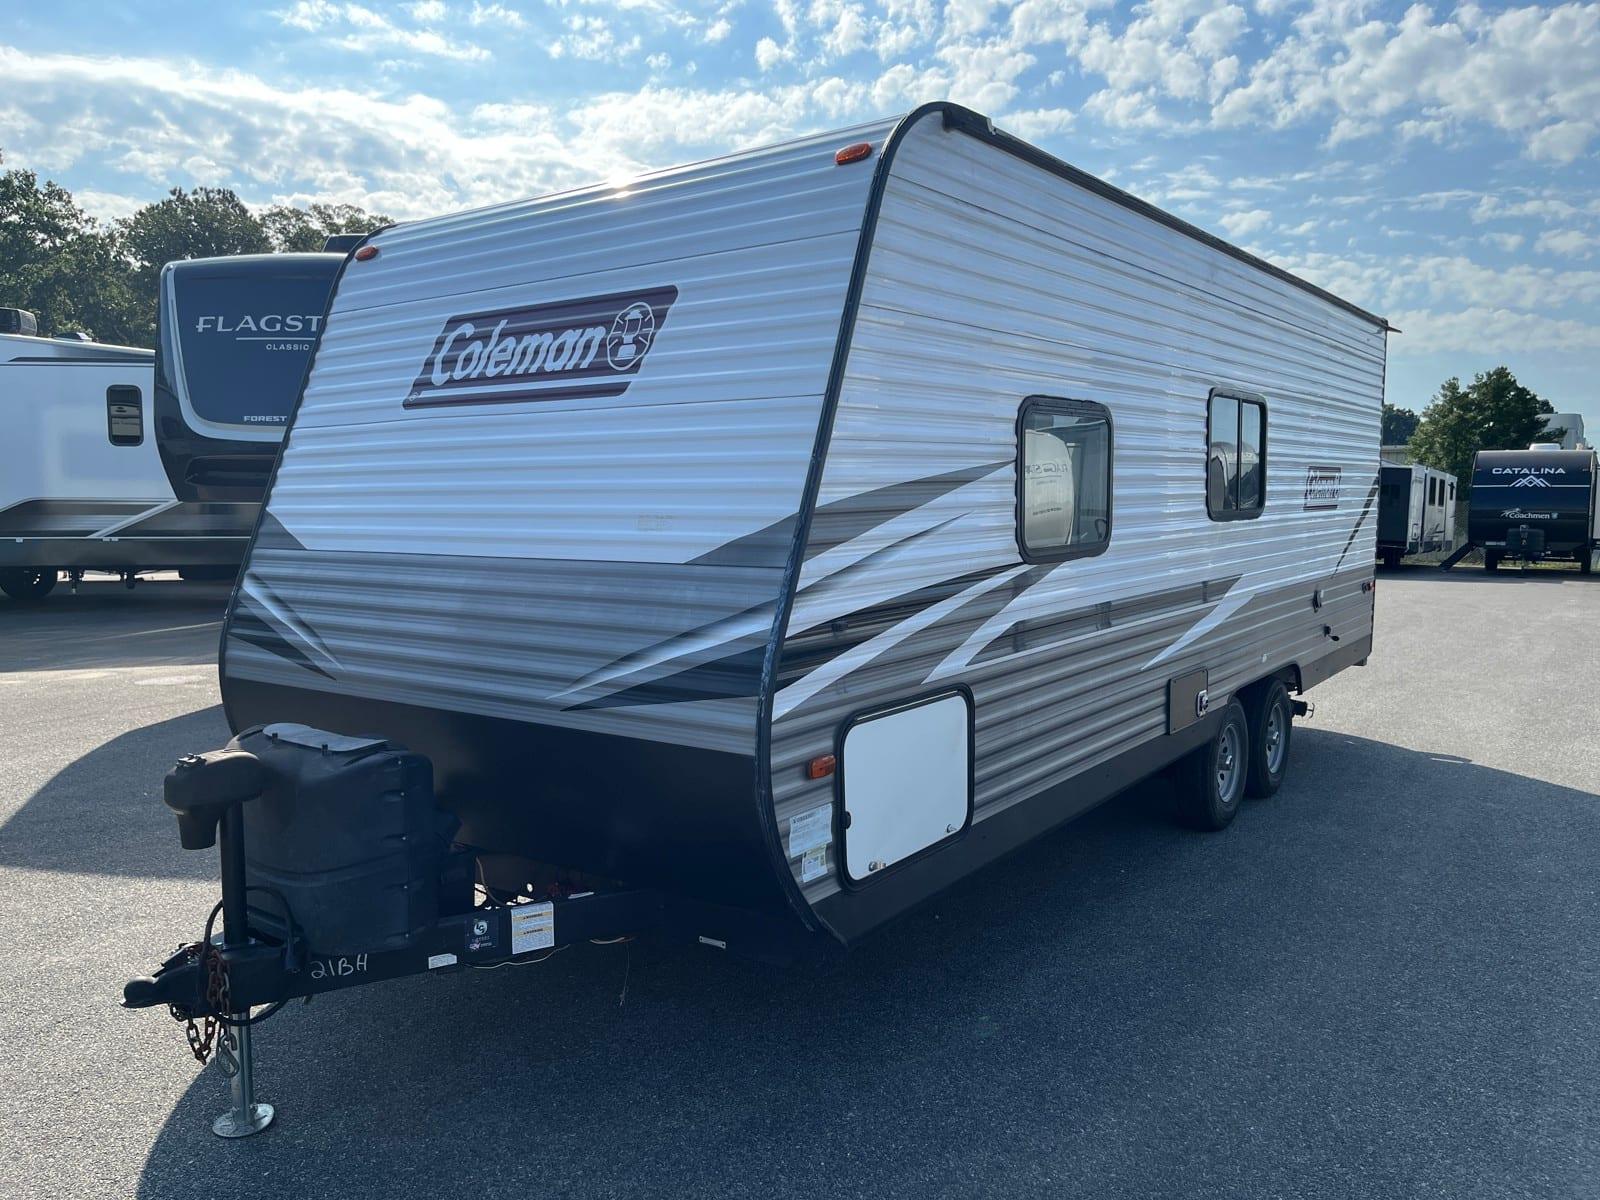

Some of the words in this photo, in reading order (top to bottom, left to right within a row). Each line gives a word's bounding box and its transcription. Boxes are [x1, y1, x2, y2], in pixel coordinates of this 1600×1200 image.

[265, 343, 310, 351] CLASSIC
[430, 319, 607, 386] Coleman
[1491, 467, 1566, 475] CATALINA
[1509, 511, 1550, 519] Coachmen
[310, 953, 368, 979] 21BH
